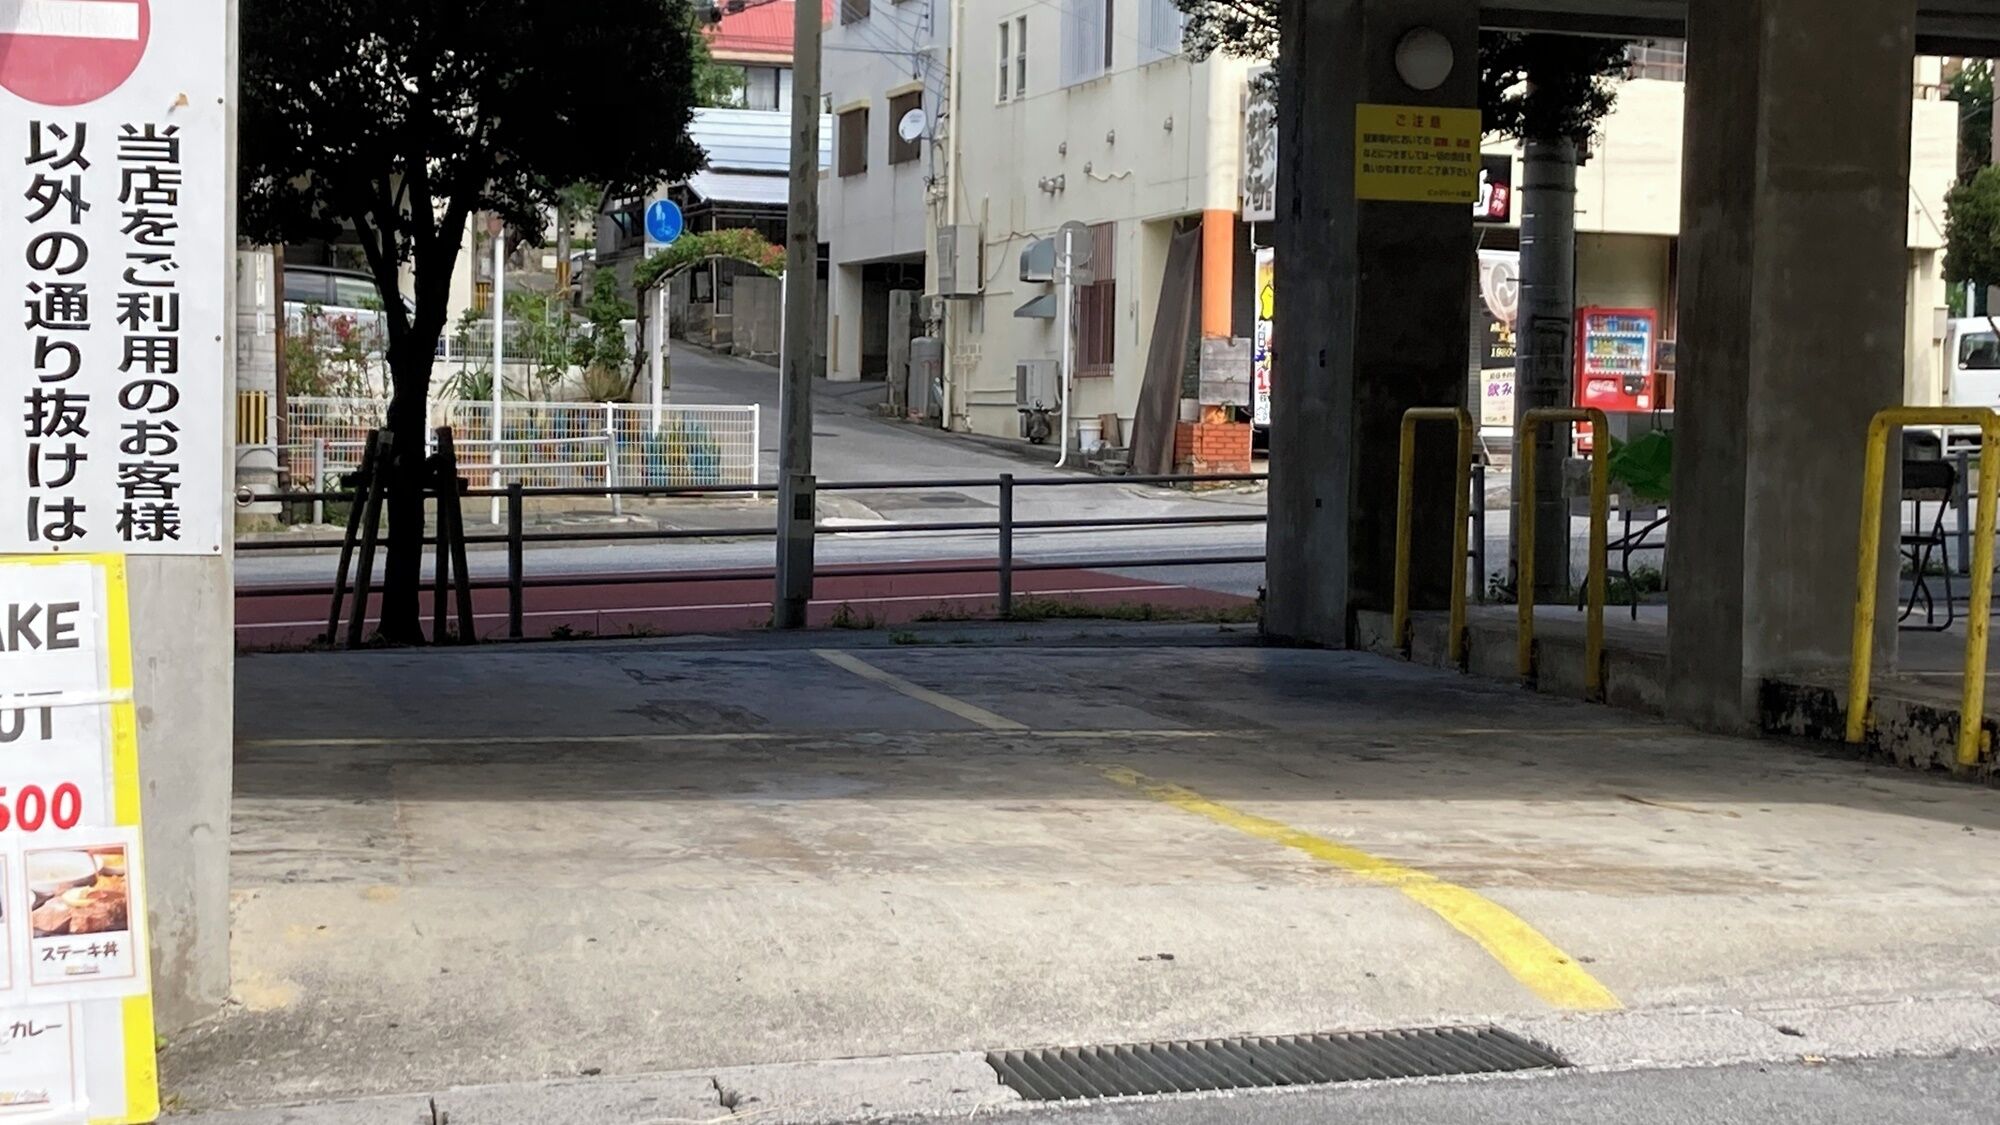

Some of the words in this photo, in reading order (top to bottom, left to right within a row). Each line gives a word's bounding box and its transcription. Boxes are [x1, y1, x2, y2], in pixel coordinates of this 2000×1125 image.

[23, 119, 91, 543] 以外の通り抜けは
[116, 122, 182, 543] 当店をご利用のお客様
[0, 601, 80, 652] KE
[41, 940, 119, 961] ステーキ丼
[9, 1020, 62, 1039] カレー
